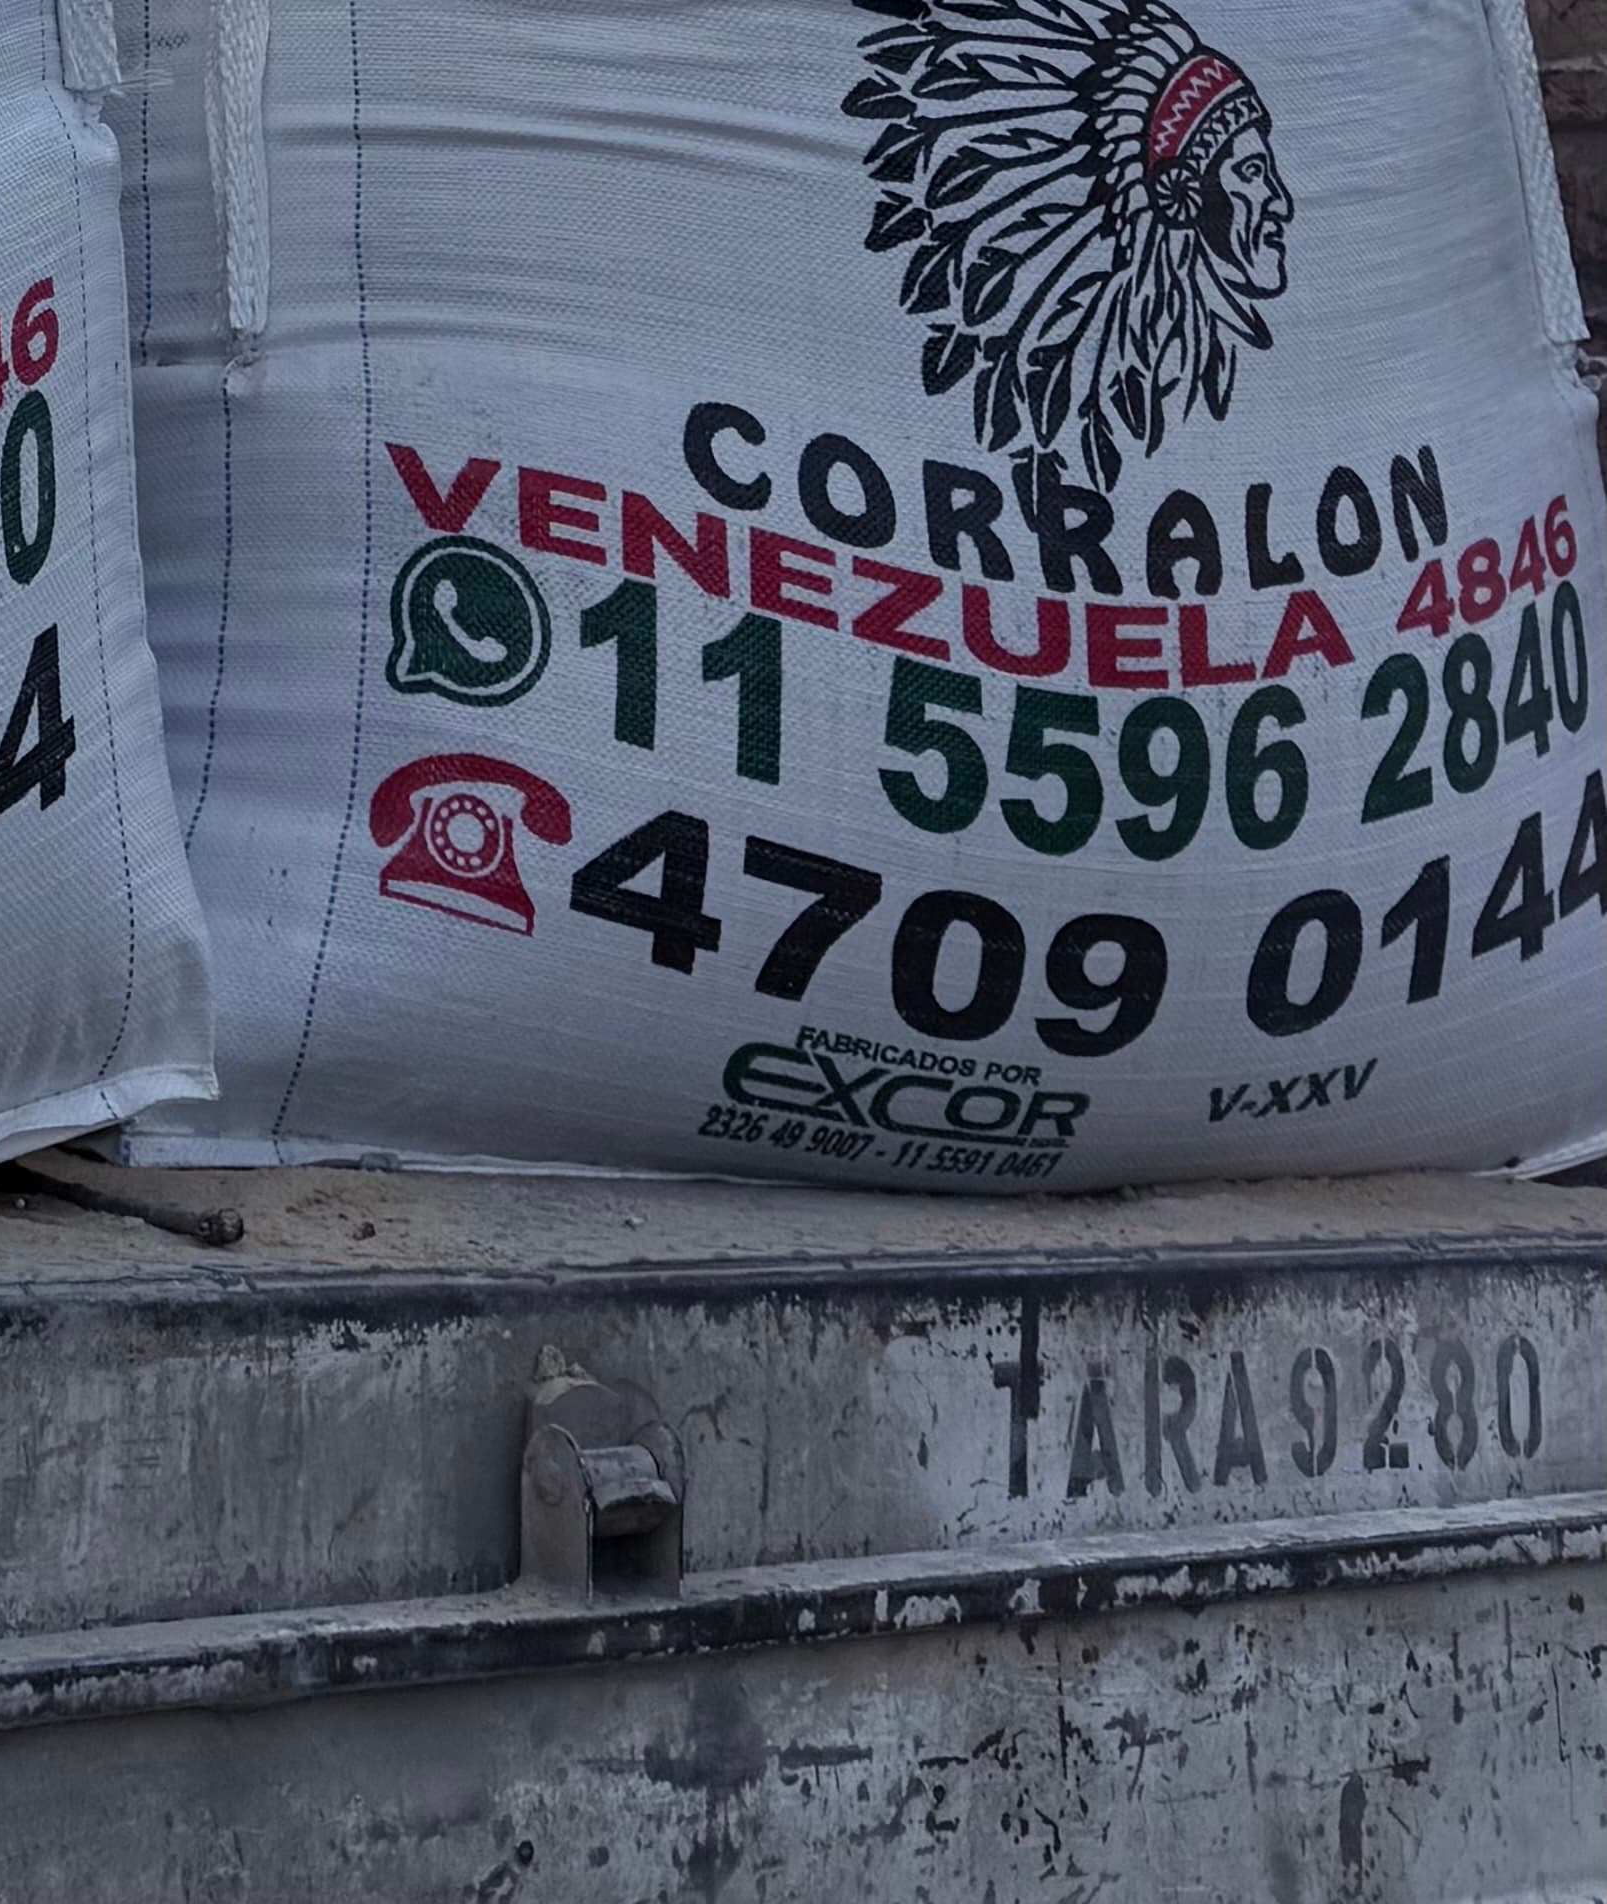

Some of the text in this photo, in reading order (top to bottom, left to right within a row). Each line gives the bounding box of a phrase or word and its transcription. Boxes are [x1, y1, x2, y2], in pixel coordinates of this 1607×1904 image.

[384, 441, 1576, 690] VENEZUELA 4846
[683, 402, 1450, 598] CORRALON
[578, 580, 1588, 861] 11 5596 2840
[569, 769, 1607, 1057] 4709 0144
[722, 1042, 1090, 1147] EXCOR
[795, 1026, 1042, 1086] FABRICADOS POR
[1208, 1058, 1378, 1122] V-XXV
[698, 1104, 769, 1142] 2326
[769, 1120, 806, 1149] 49
[809, 1126, 874, 1161] 9007
[894, 1140, 924, 1169] 11
[927, 1143, 993, 1177] 5591
[997, 1150, 1063, 1178] 0461
